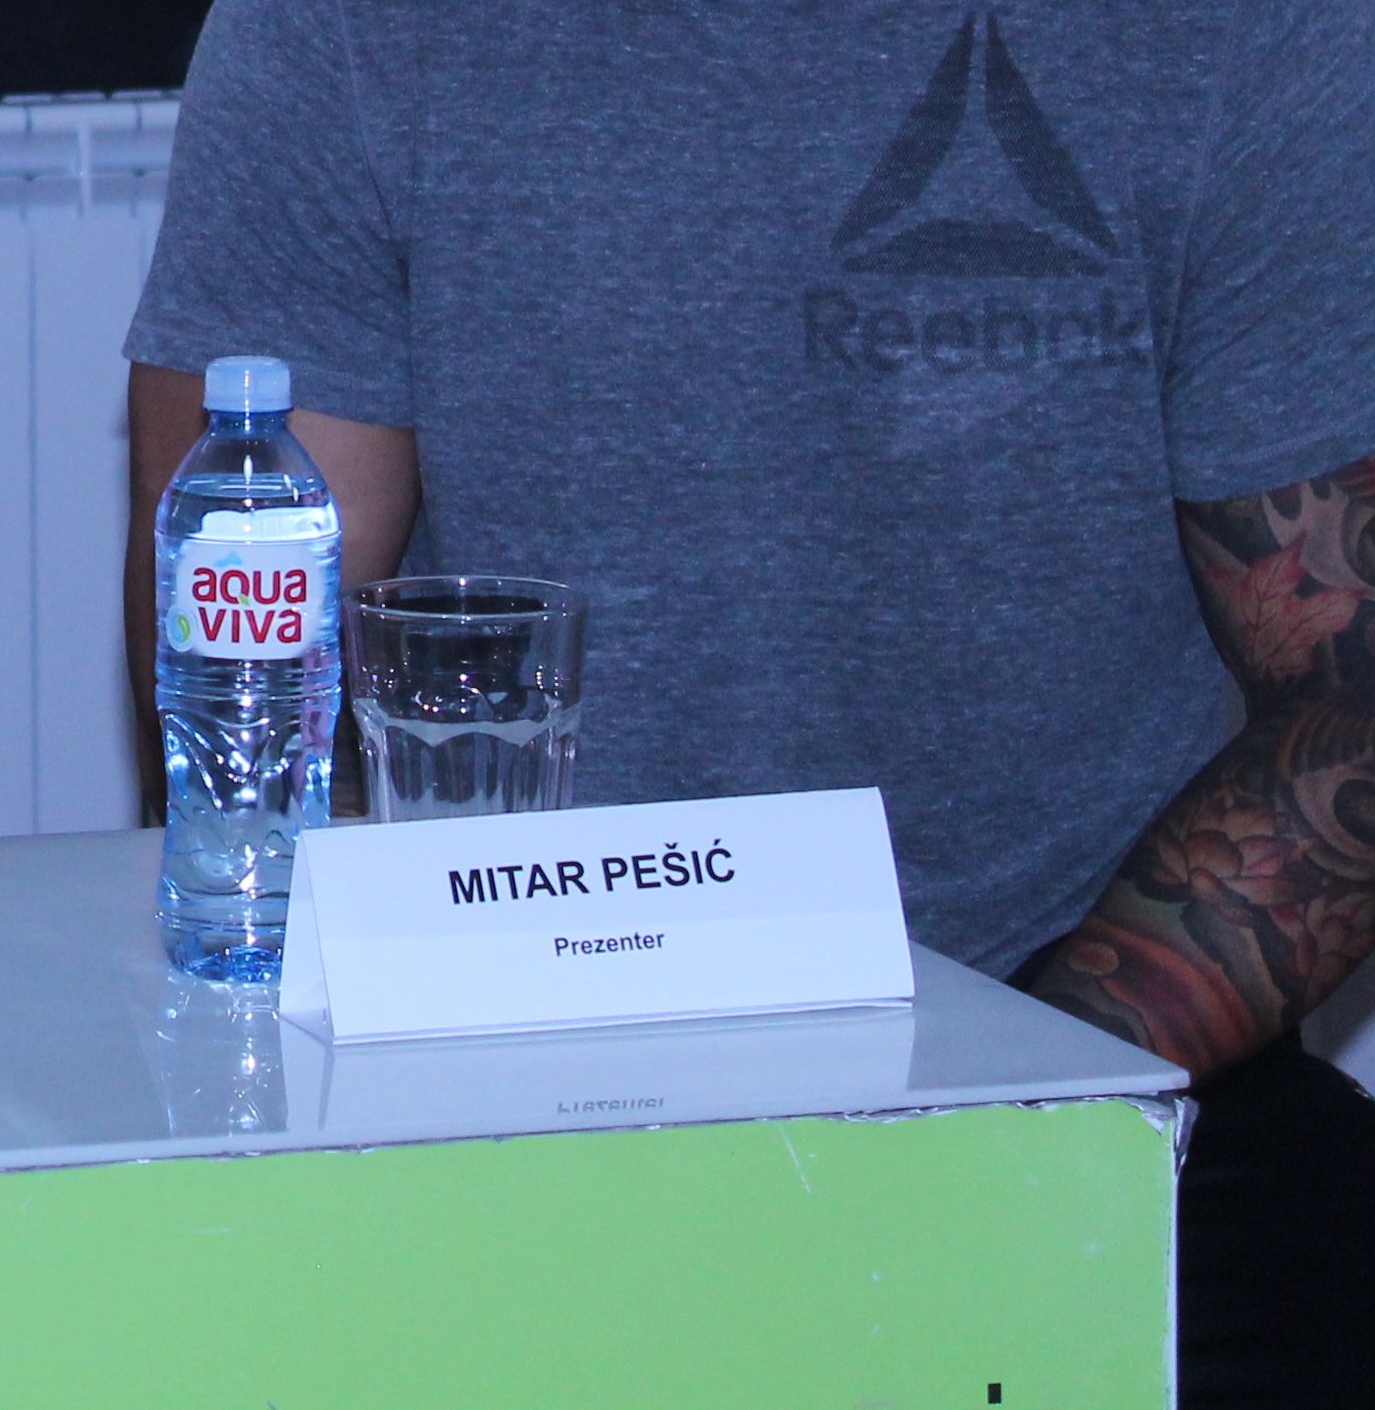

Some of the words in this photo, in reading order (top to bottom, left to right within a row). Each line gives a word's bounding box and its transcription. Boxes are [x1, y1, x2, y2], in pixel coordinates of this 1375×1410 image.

[192, 567, 307, 605] aqua
[198, 606, 302, 644] viva
[448, 861, 590, 905] MITAR
[601, 838, 736, 892] PEŠIĆ
[553, 931, 665, 958] Prezenter
